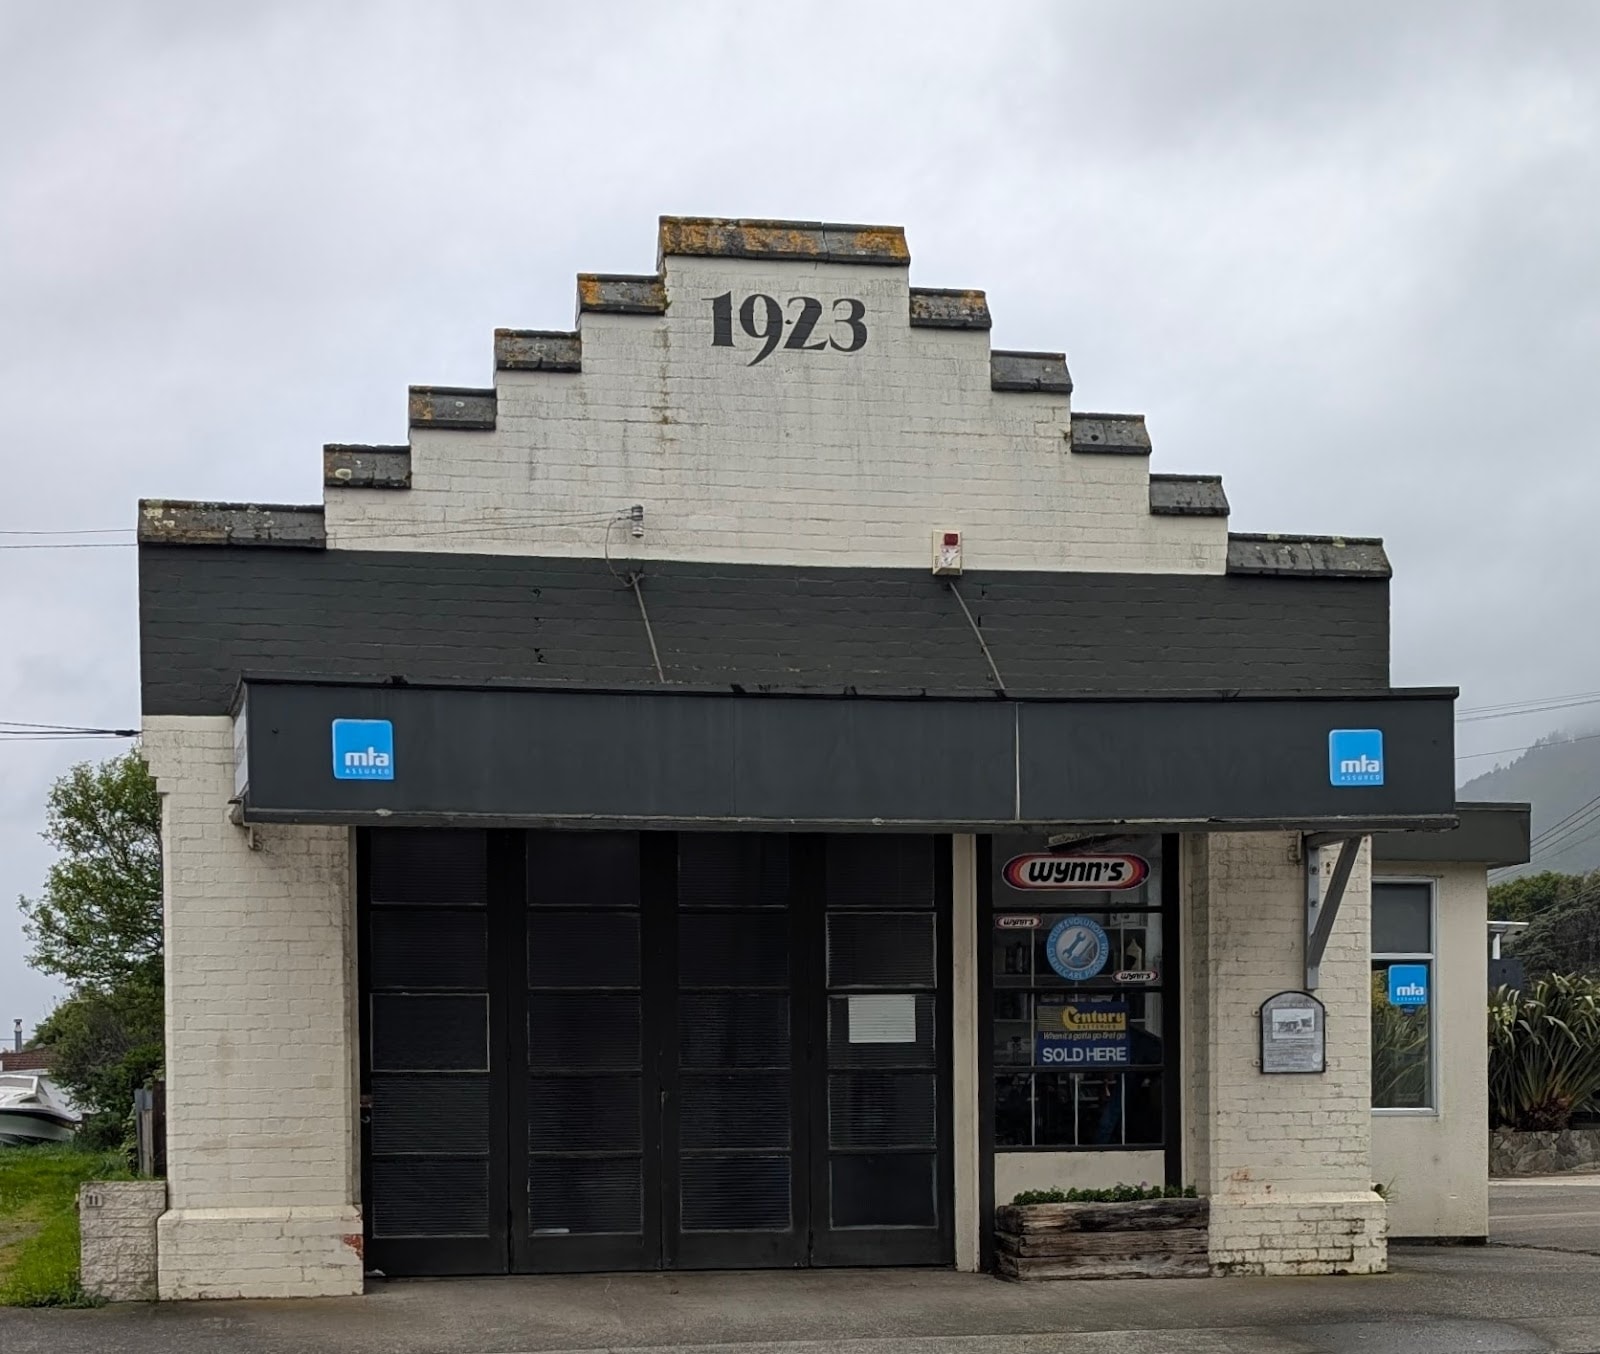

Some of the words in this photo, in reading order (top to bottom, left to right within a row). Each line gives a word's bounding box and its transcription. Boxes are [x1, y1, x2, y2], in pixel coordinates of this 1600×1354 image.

[701, 290, 867, 367] 1923
[345, 746, 389, 766] mta
[1341, 754, 1380, 773] mta
[1396, 982, 1424, 996] mta
[1062, 1006, 1126, 1027] Century
[1042, 1047, 1083, 1062] SOLD
[1086, 1047, 1127, 1062] HERE
